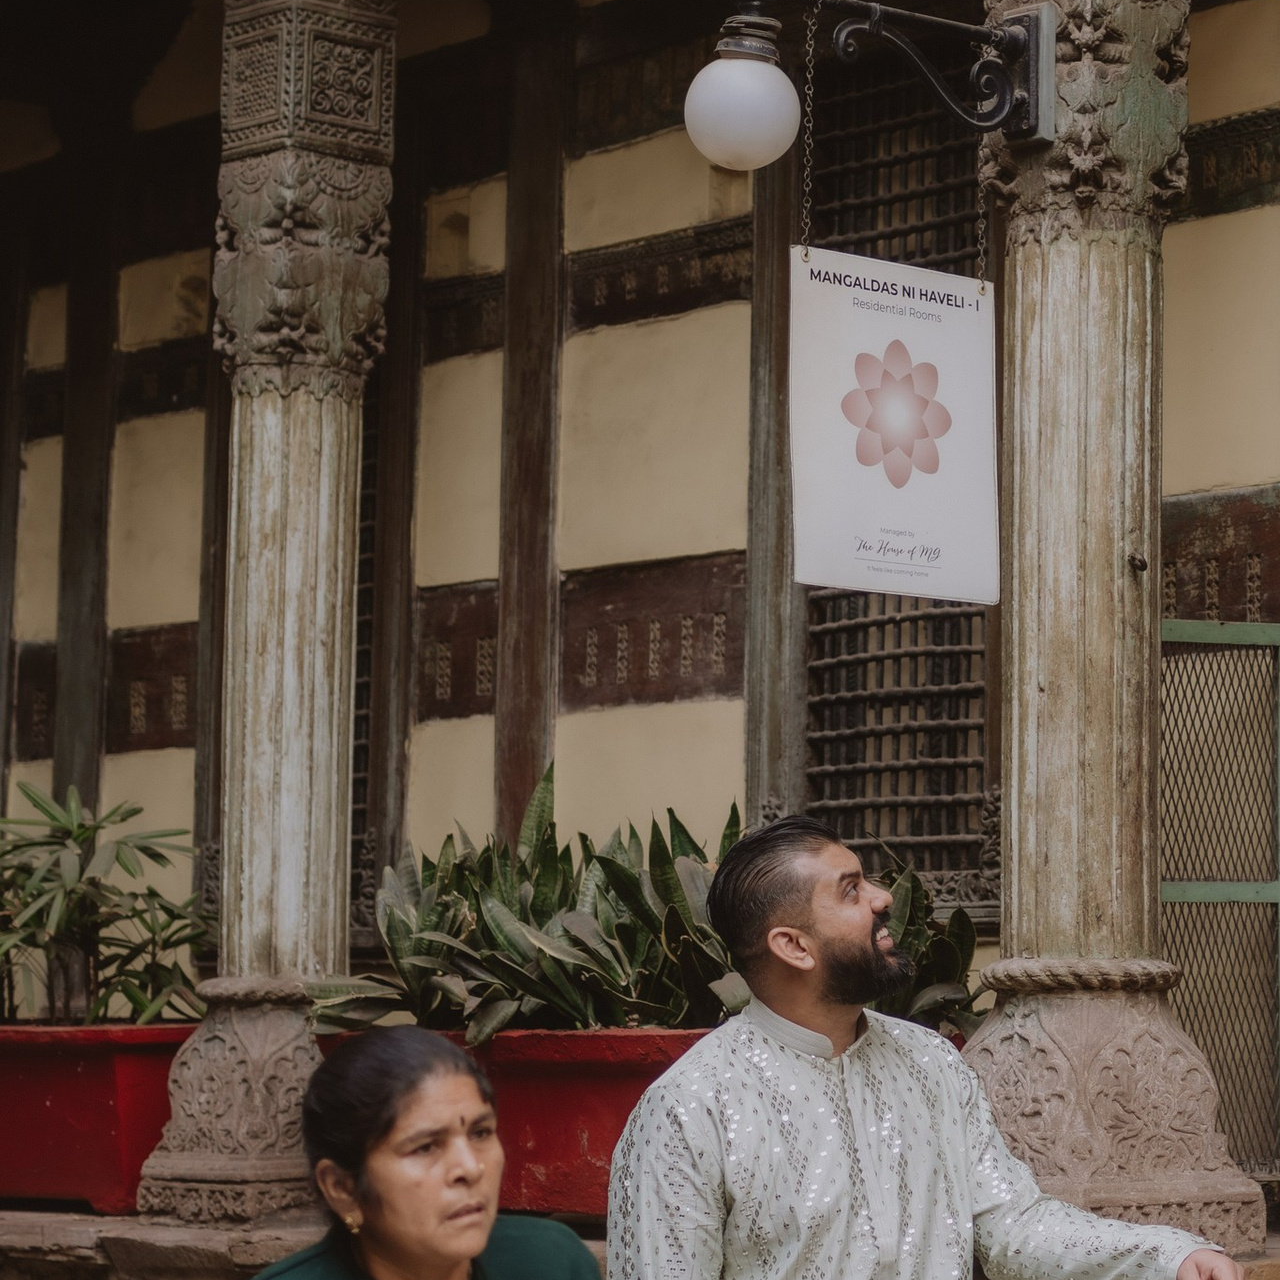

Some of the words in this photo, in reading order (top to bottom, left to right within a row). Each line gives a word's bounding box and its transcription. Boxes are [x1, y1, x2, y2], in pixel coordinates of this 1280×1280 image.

[809, 268, 899, 296] MANGALDAS
[902, 285, 916, 300] NI
[919, 288, 965, 309] HAVELI
[852, 297, 907, 317] Residential
[909, 307, 943, 323] Rooms
[880, 527, 907, 537] Managed
[854, 536, 874, 552] The
[877, 539, 905, 557] House
[907, 545, 917, 561] of
